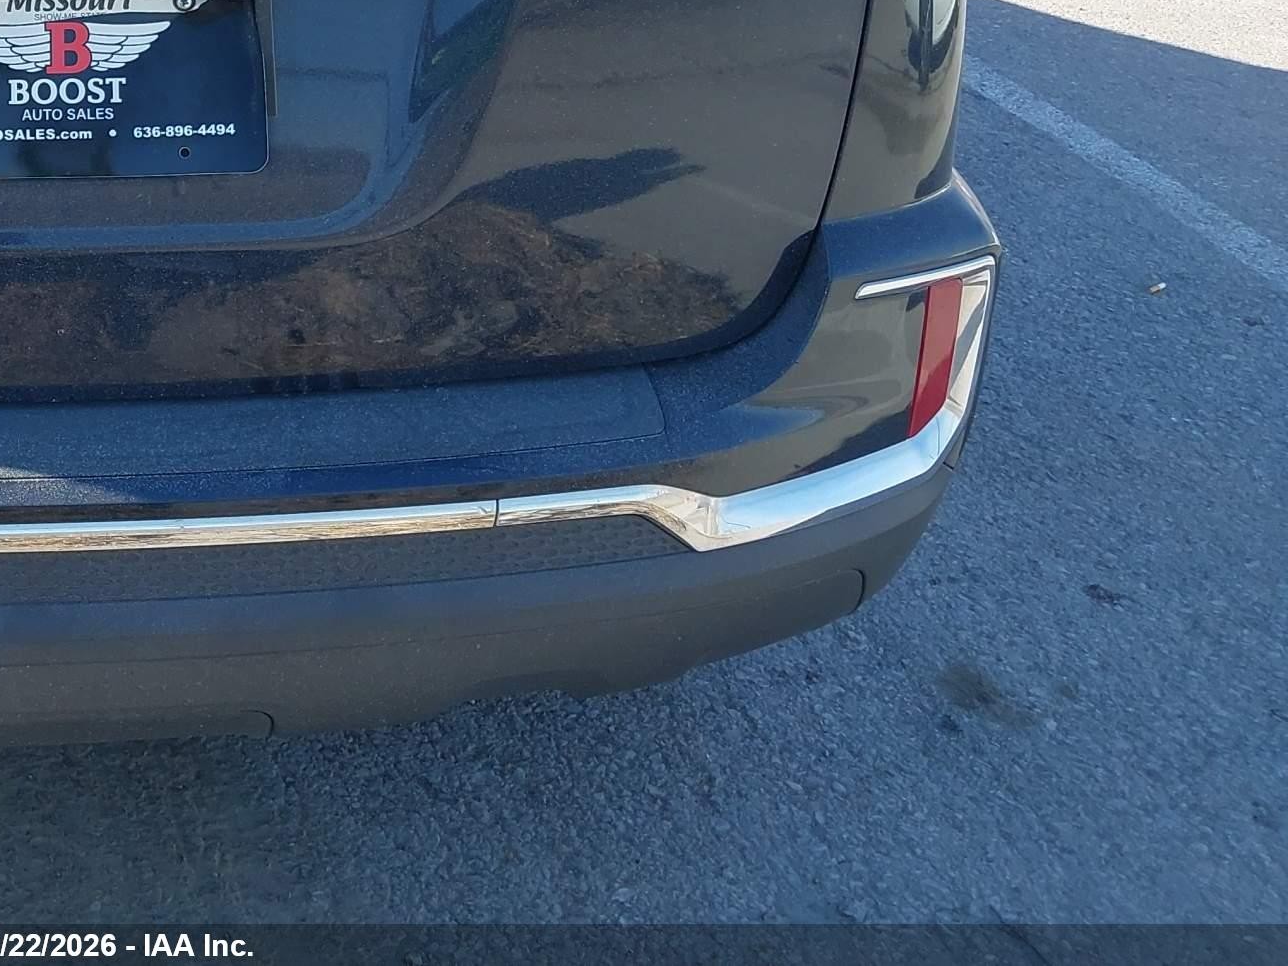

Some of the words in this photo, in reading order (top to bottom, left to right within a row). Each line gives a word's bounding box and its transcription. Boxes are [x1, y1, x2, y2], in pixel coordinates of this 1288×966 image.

[44, 19, 93, 75] B
[7, 77, 127, 105] BOOST
[22, 108, 63, 121] AUTO
[66, 107, 115, 120] SALES
[133, 123, 236, 138] 636-896-4494
